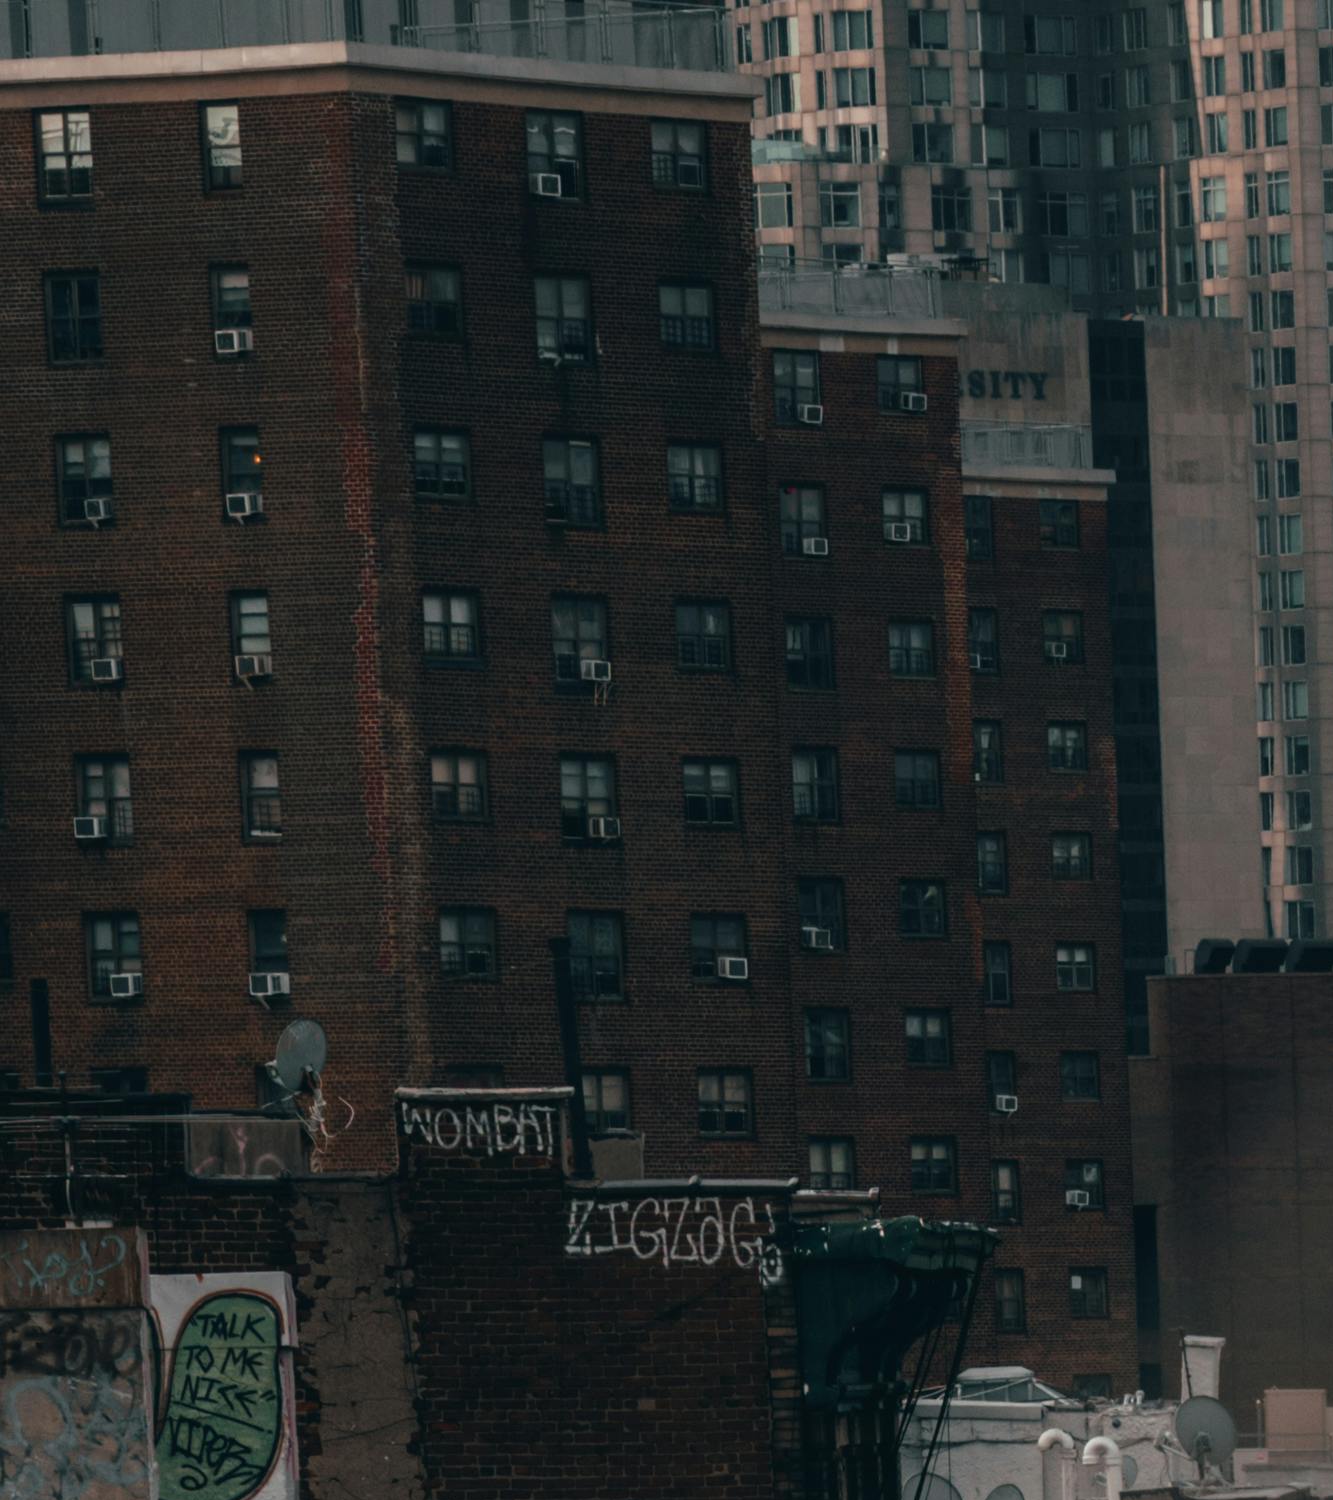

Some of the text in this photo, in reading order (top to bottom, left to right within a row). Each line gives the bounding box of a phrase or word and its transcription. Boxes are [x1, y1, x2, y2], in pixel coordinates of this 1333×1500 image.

[401, 1101, 559, 1158] WOMBAT
[185, 1346, 265, 1380] TO ME
